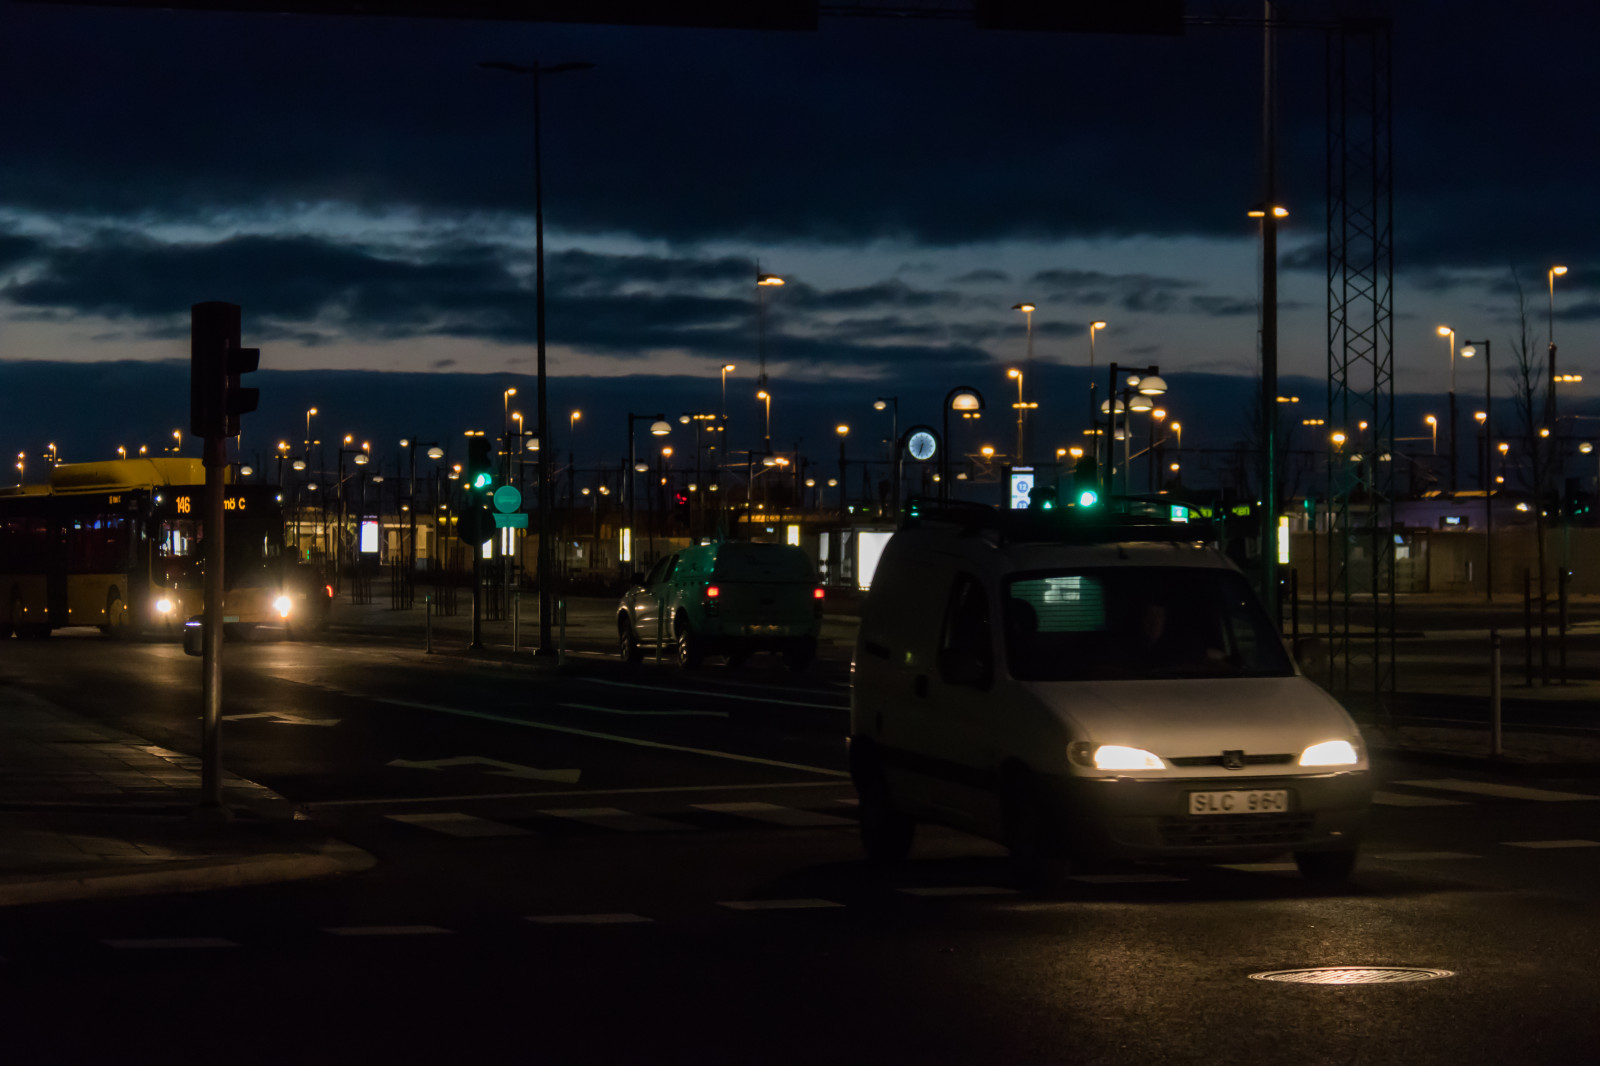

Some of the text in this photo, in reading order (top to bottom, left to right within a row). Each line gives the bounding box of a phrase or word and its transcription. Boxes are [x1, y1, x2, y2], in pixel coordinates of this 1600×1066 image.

[176, 496, 190, 513] 146
[238, 497, 246, 510] C
[1195, 791, 1284, 812] SLC 960
